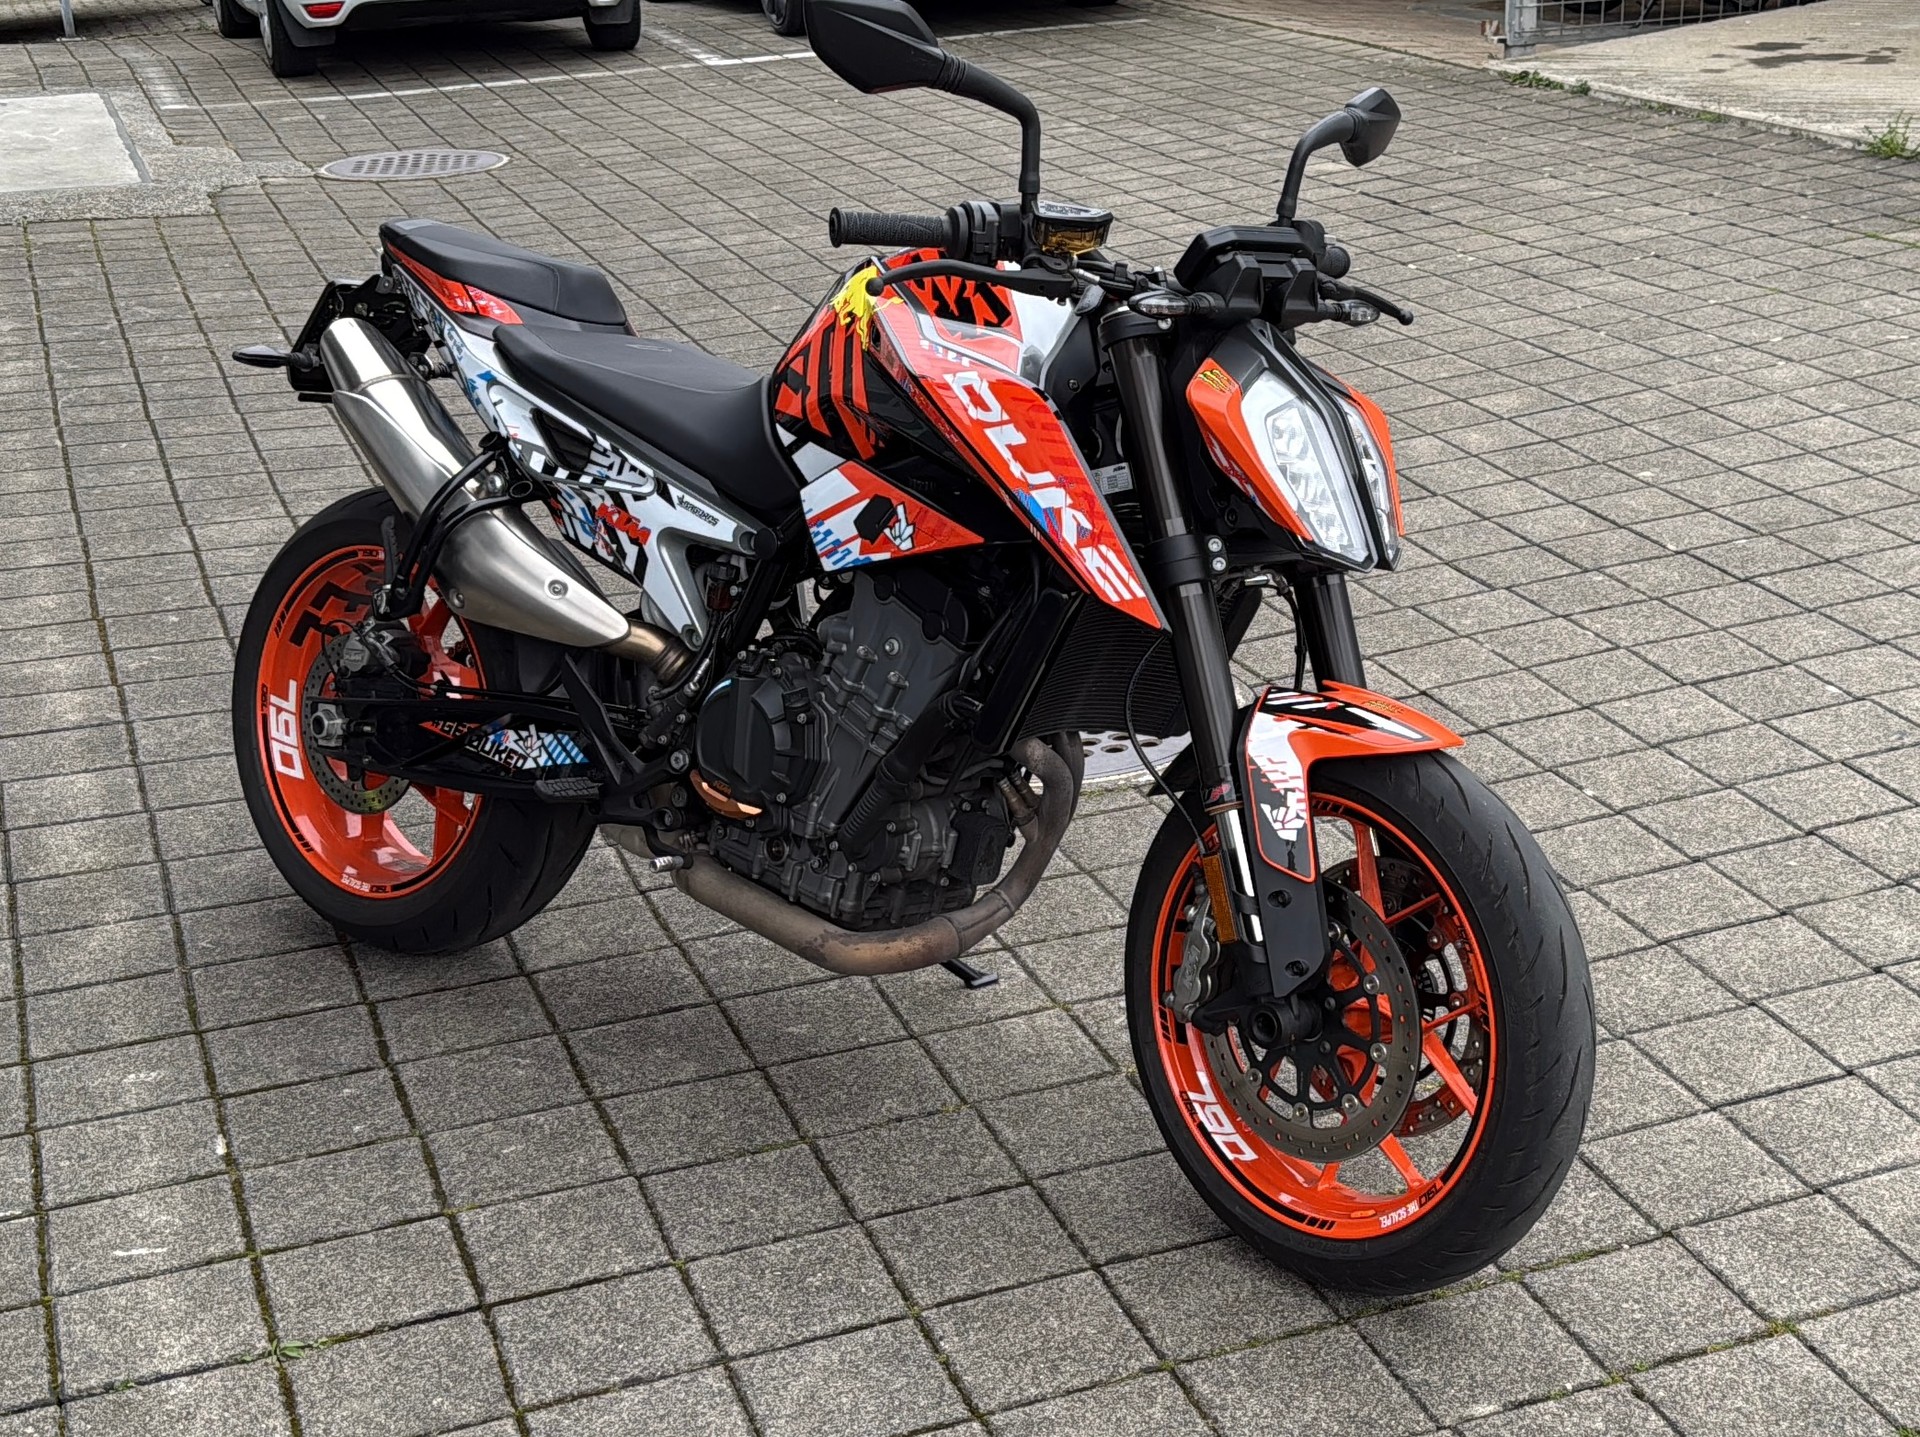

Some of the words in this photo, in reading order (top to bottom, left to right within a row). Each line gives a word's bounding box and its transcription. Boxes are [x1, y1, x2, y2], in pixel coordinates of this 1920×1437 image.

[942, 370, 1147, 602] DUKE
[595, 501, 652, 545] KTM
[269, 679, 305, 780] 790
[1188, 1071, 1259, 1161] 790
[1379, 1207, 1407, 1228] SCALPEL
[1407, 1200, 1420, 1217] THE
[1418, 1183, 1443, 1208] 790
